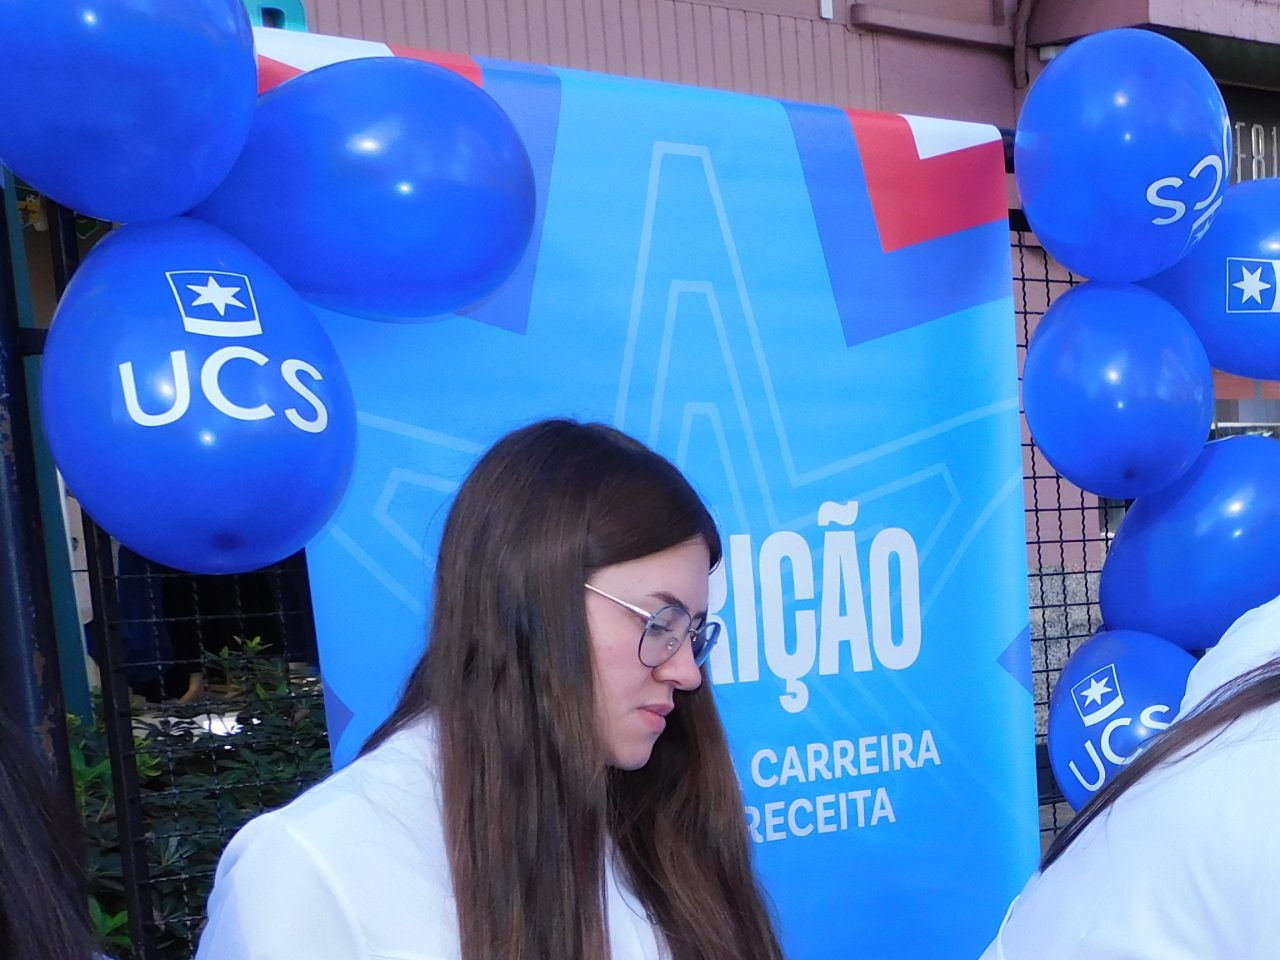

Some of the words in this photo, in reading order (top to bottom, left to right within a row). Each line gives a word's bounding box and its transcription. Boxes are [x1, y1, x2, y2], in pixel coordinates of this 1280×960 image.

[119, 346, 328, 433] UCS
[751, 730, 942, 788] CARREIRA
[1069, 704, 1170, 792] UCS
[744, 787, 897, 844] RECEITA
